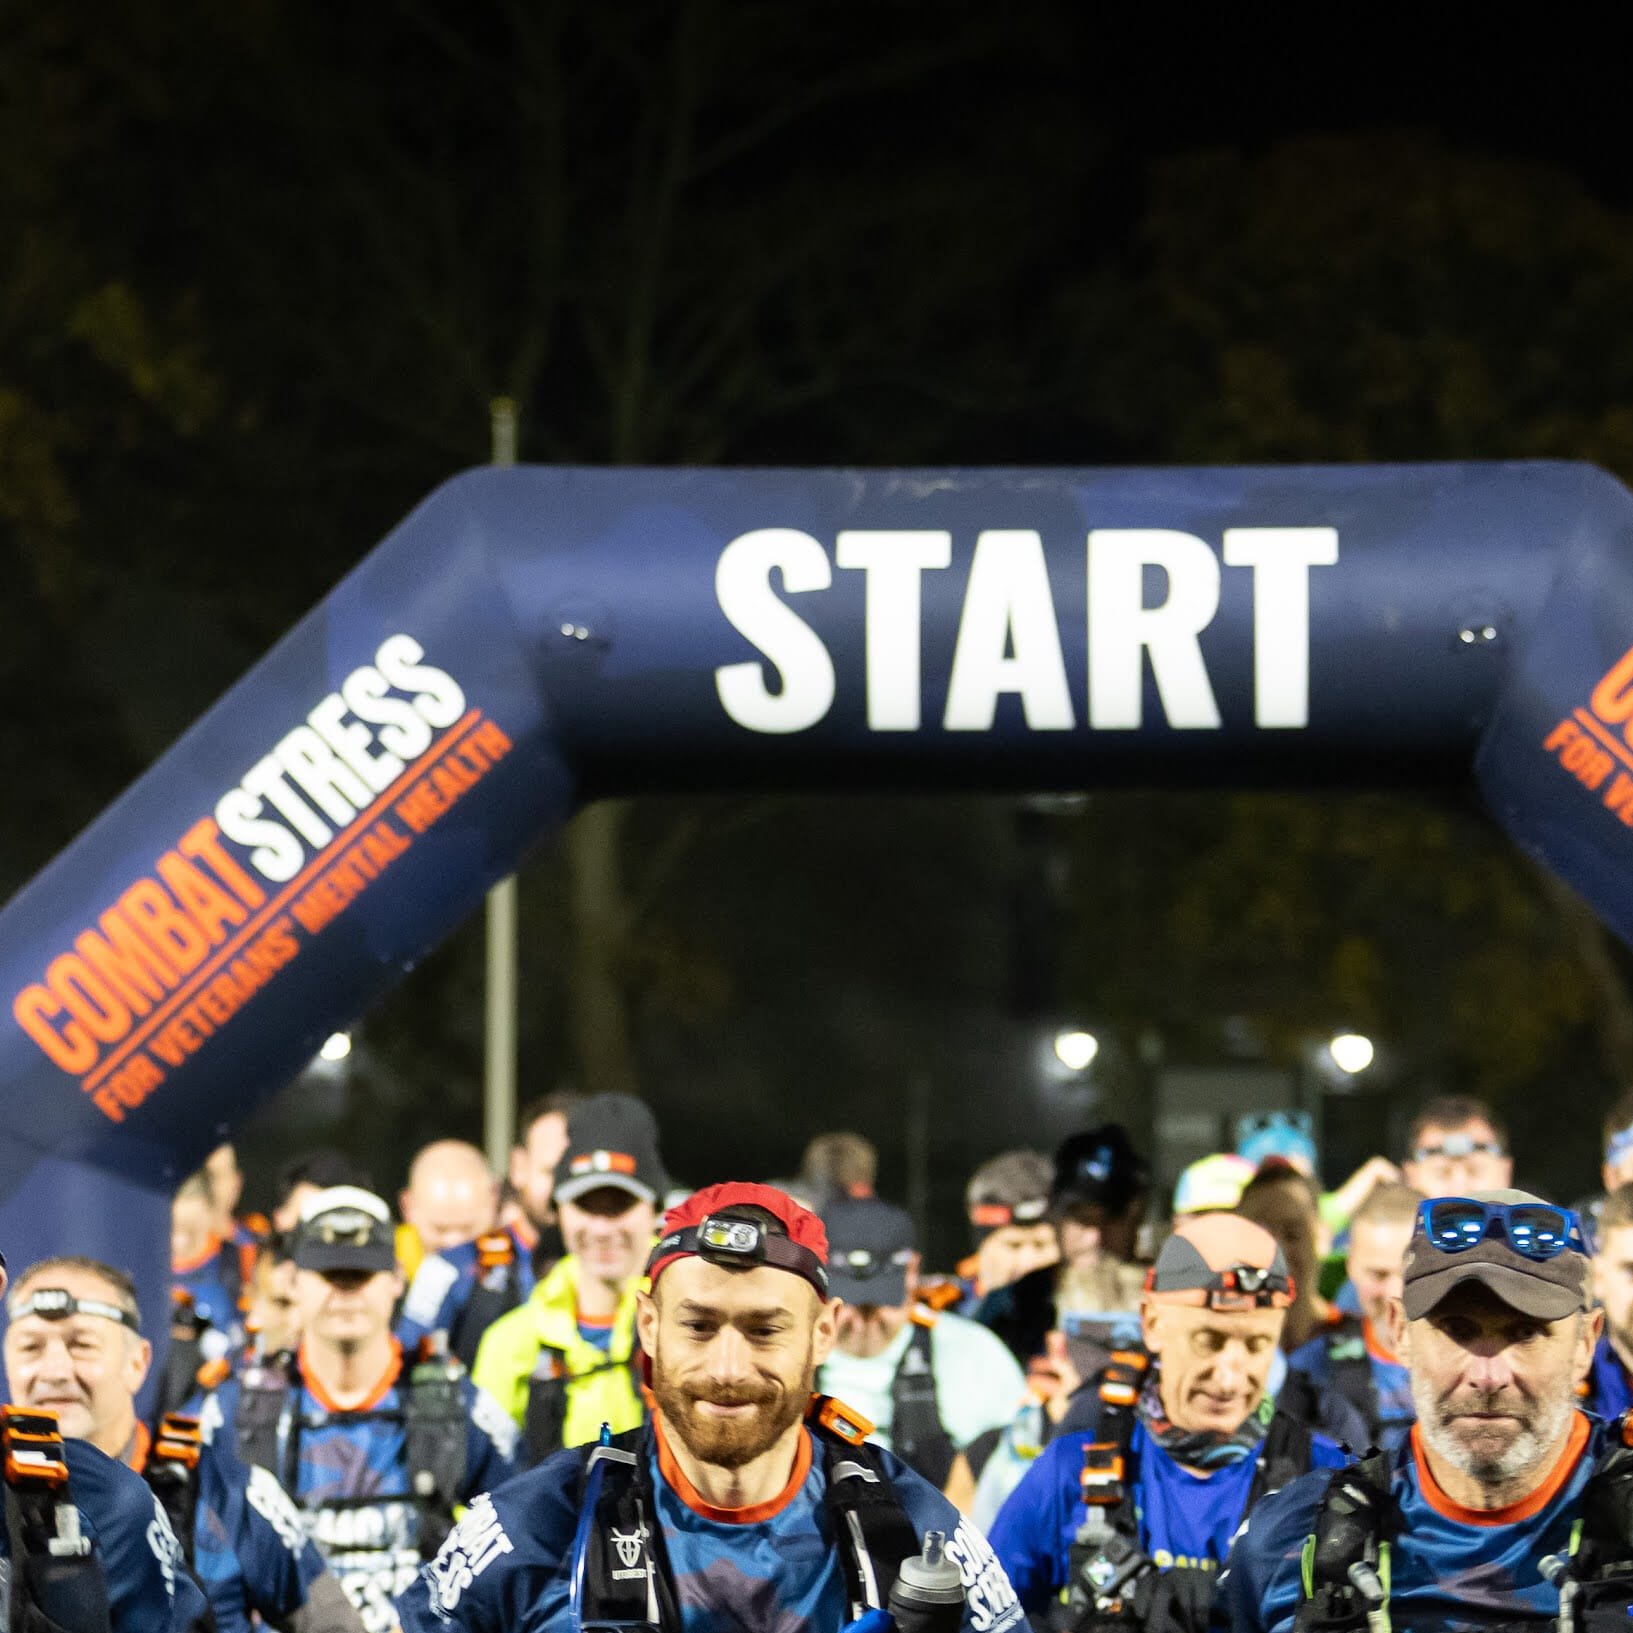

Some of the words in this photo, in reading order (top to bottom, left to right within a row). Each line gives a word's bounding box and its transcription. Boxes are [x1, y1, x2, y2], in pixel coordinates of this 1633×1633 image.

[714, 527, 1339, 734] START
[1544, 720, 1614, 791] FOR
[92, 1048, 165, 1124] FOR
[297, 816, 413, 936] MENTAL
[395, 719, 514, 836] HEALTH
